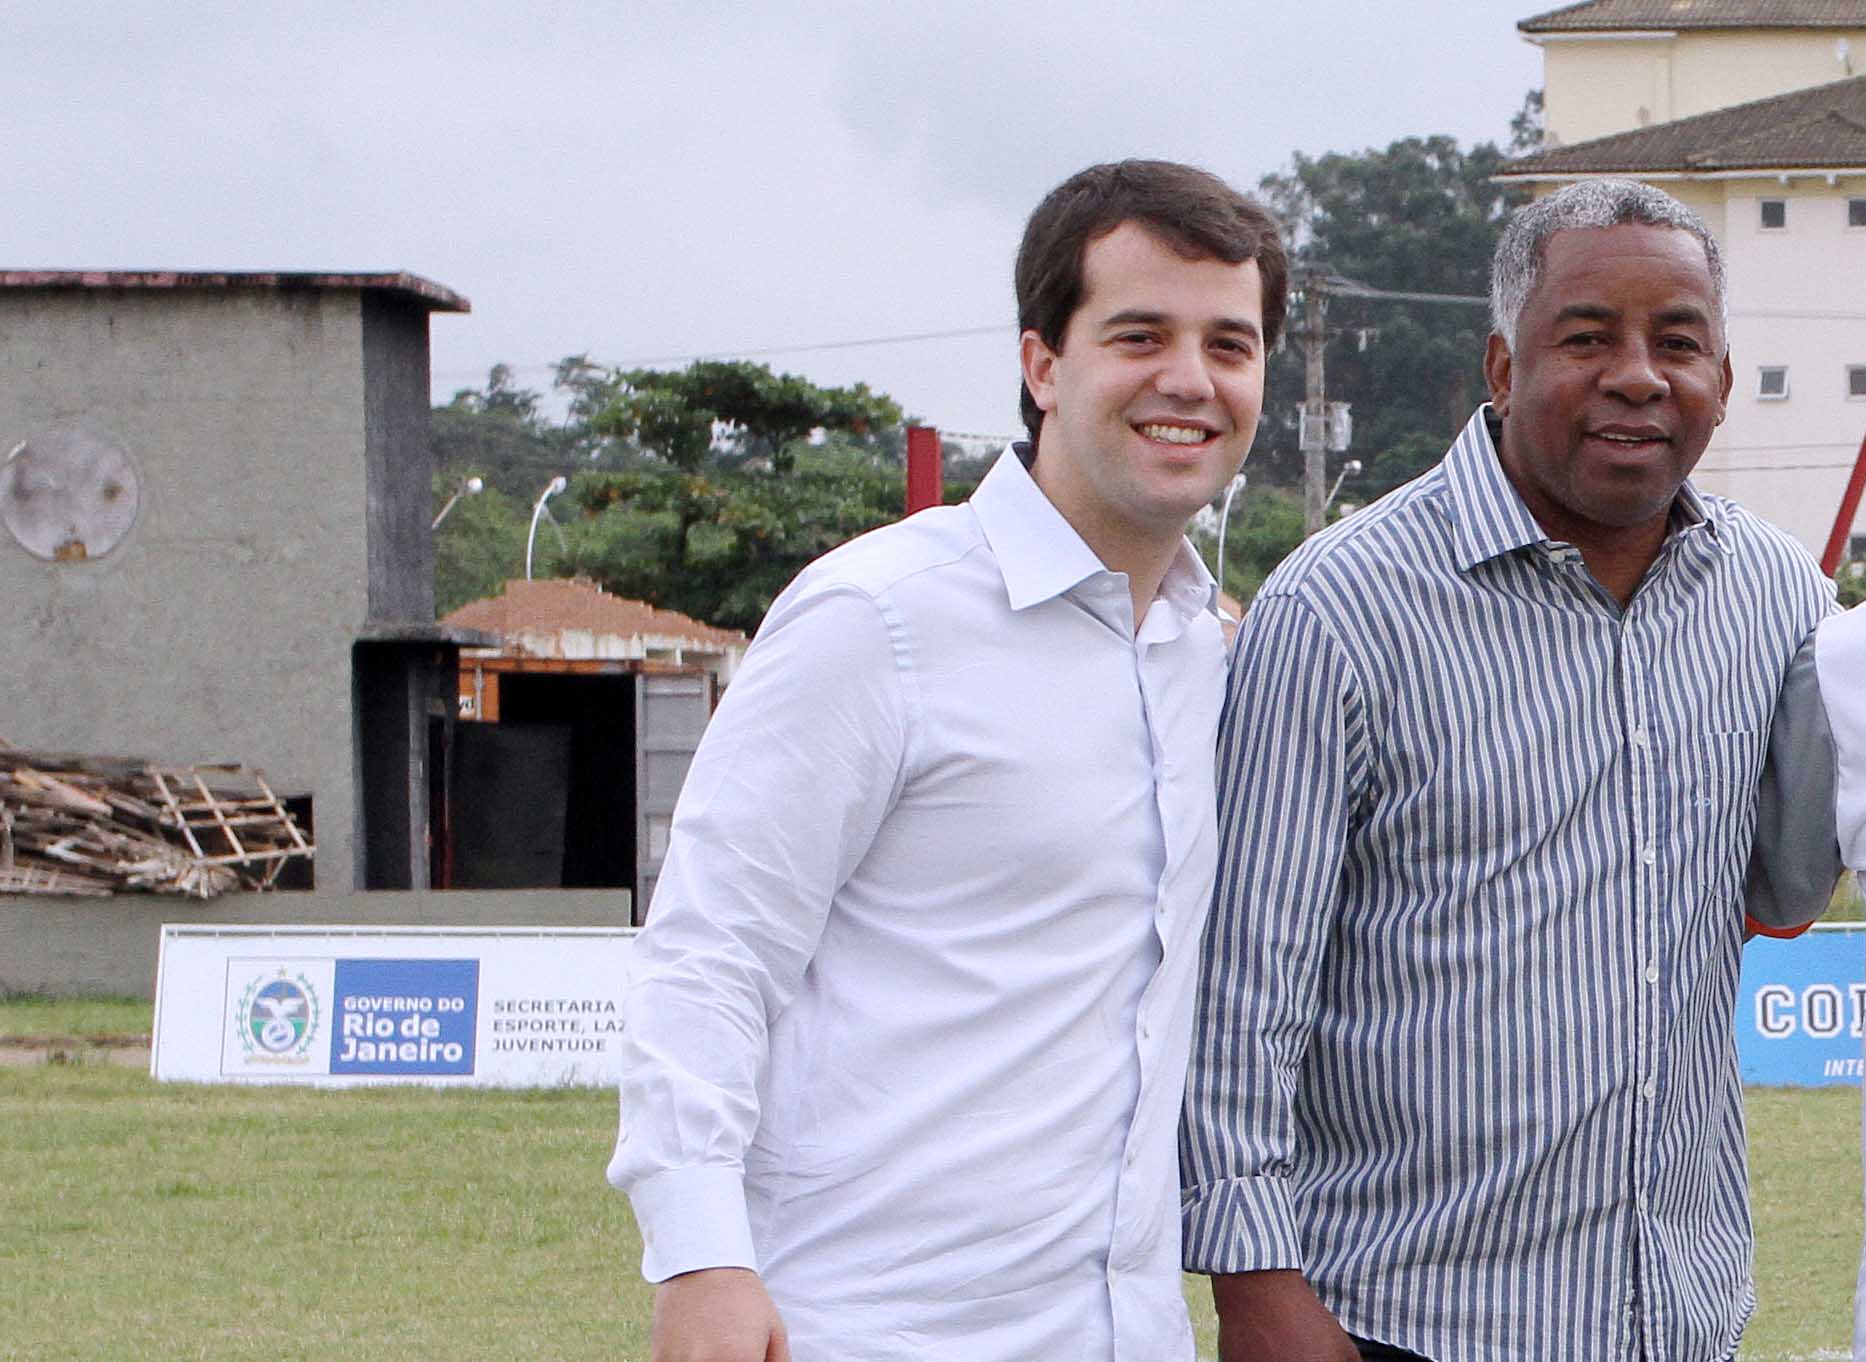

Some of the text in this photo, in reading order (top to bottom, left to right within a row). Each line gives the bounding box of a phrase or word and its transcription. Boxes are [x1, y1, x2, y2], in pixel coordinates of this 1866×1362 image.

[344, 996, 465, 1012] GOVERNO DO
[493, 1000, 616, 1014] SECRETARIA
[343, 1012, 440, 1037] Rio de
[493, 1019, 585, 1035] ESPORTE,
[340, 1037, 463, 1062] Janeiro
[493, 1038, 607, 1052] JUVENTUDE
